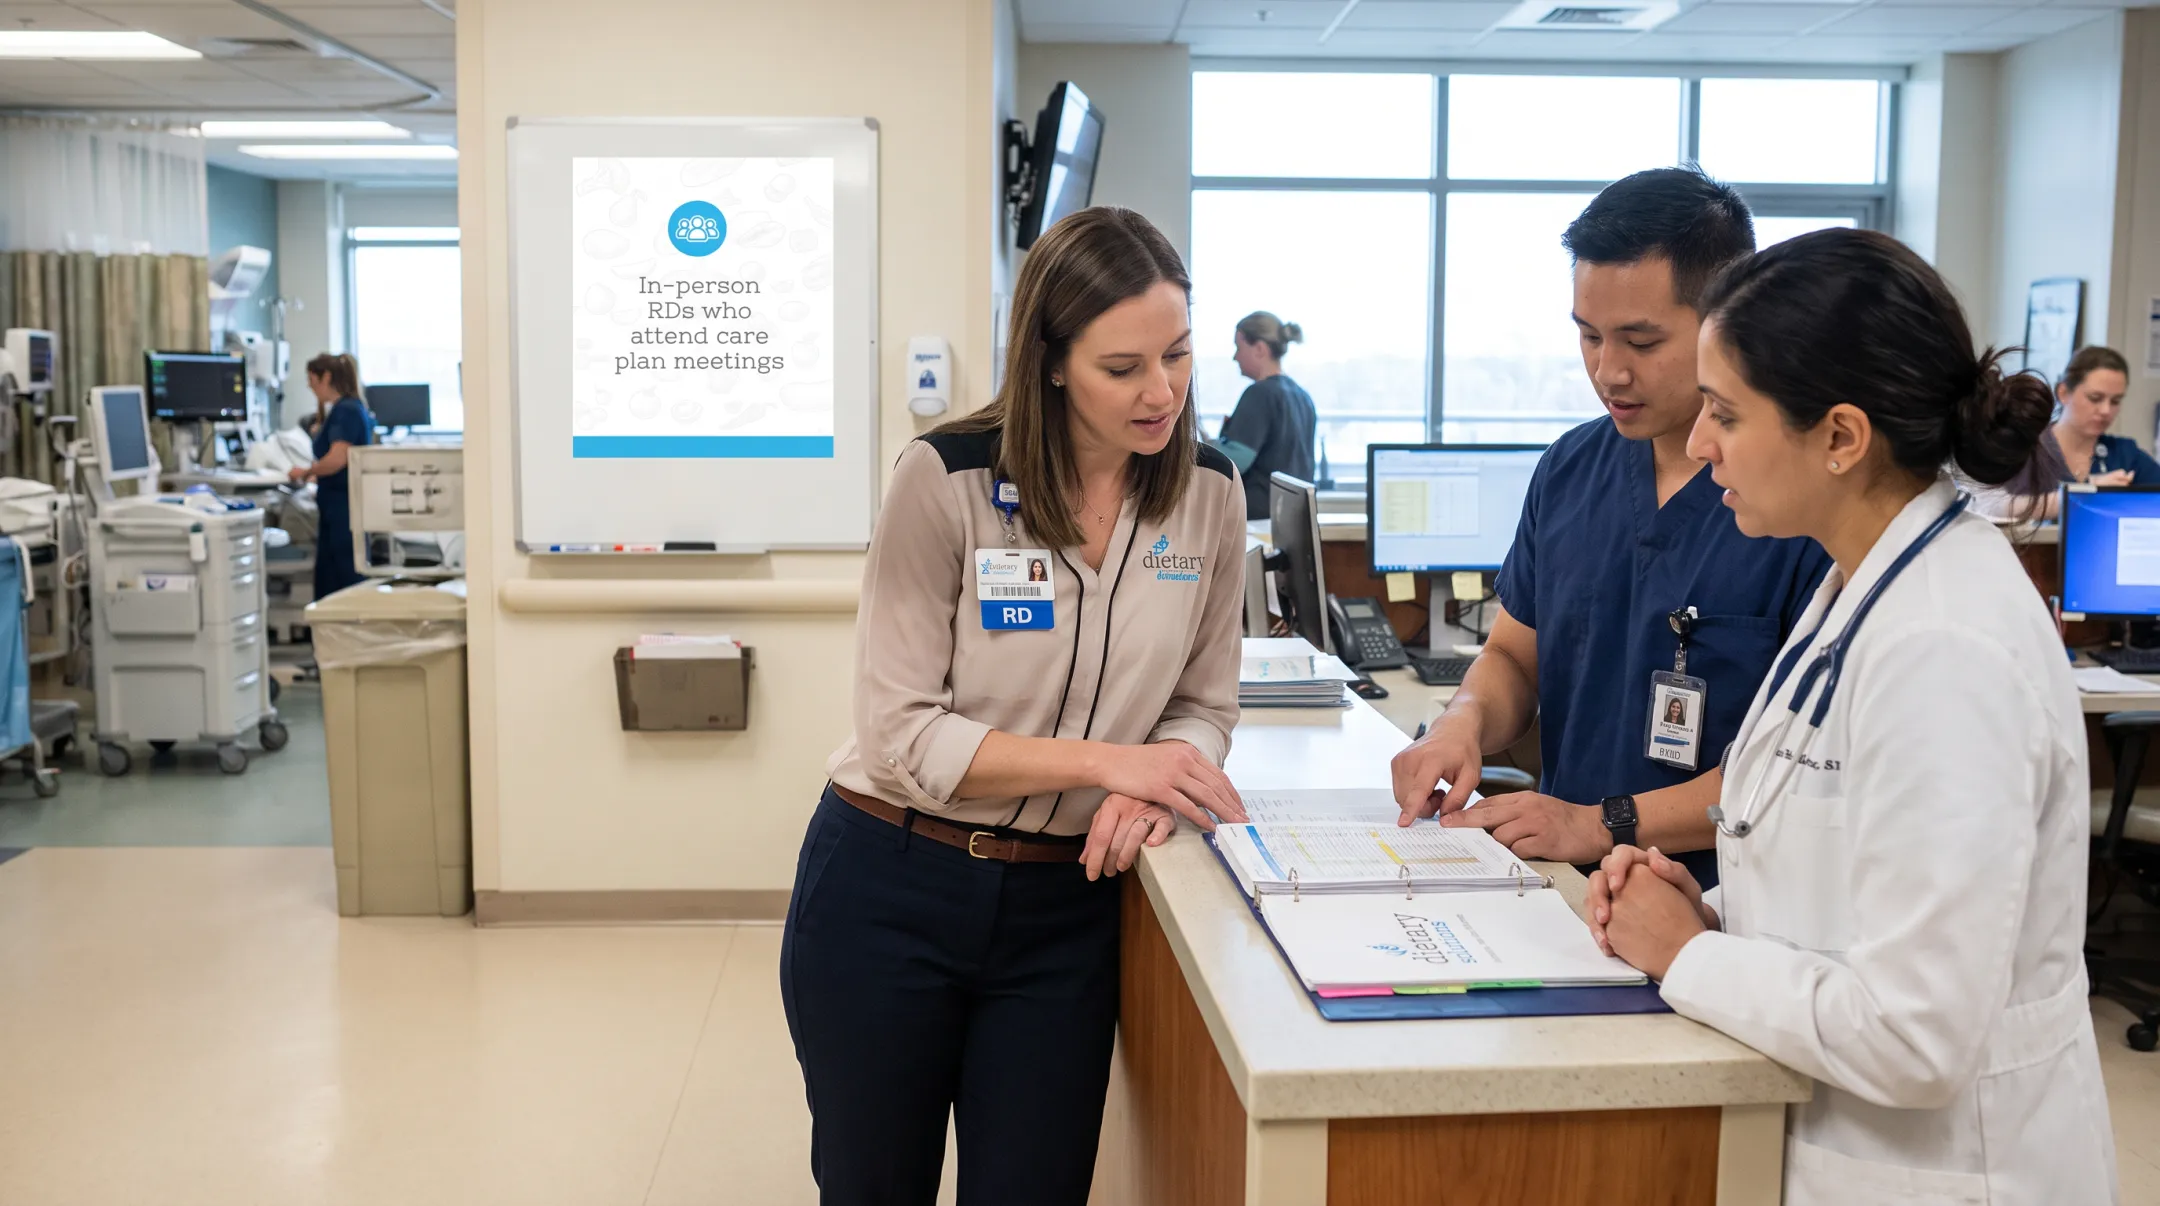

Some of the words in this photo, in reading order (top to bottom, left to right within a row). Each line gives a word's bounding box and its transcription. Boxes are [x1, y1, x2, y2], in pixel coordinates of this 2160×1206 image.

[638, 276, 761, 299] In-person
[647, 301, 695, 319] RDs
[702, 301, 752, 319] who
[630, 326, 708, 344] attend
[716, 330, 769, 344] care
[614, 351, 666, 375] plan
[673, 351, 785, 374] meetings
[1142, 550, 1206, 574] dietary
[1002, 607, 1033, 624] RD
[1393, 912, 1449, 964] dietary
